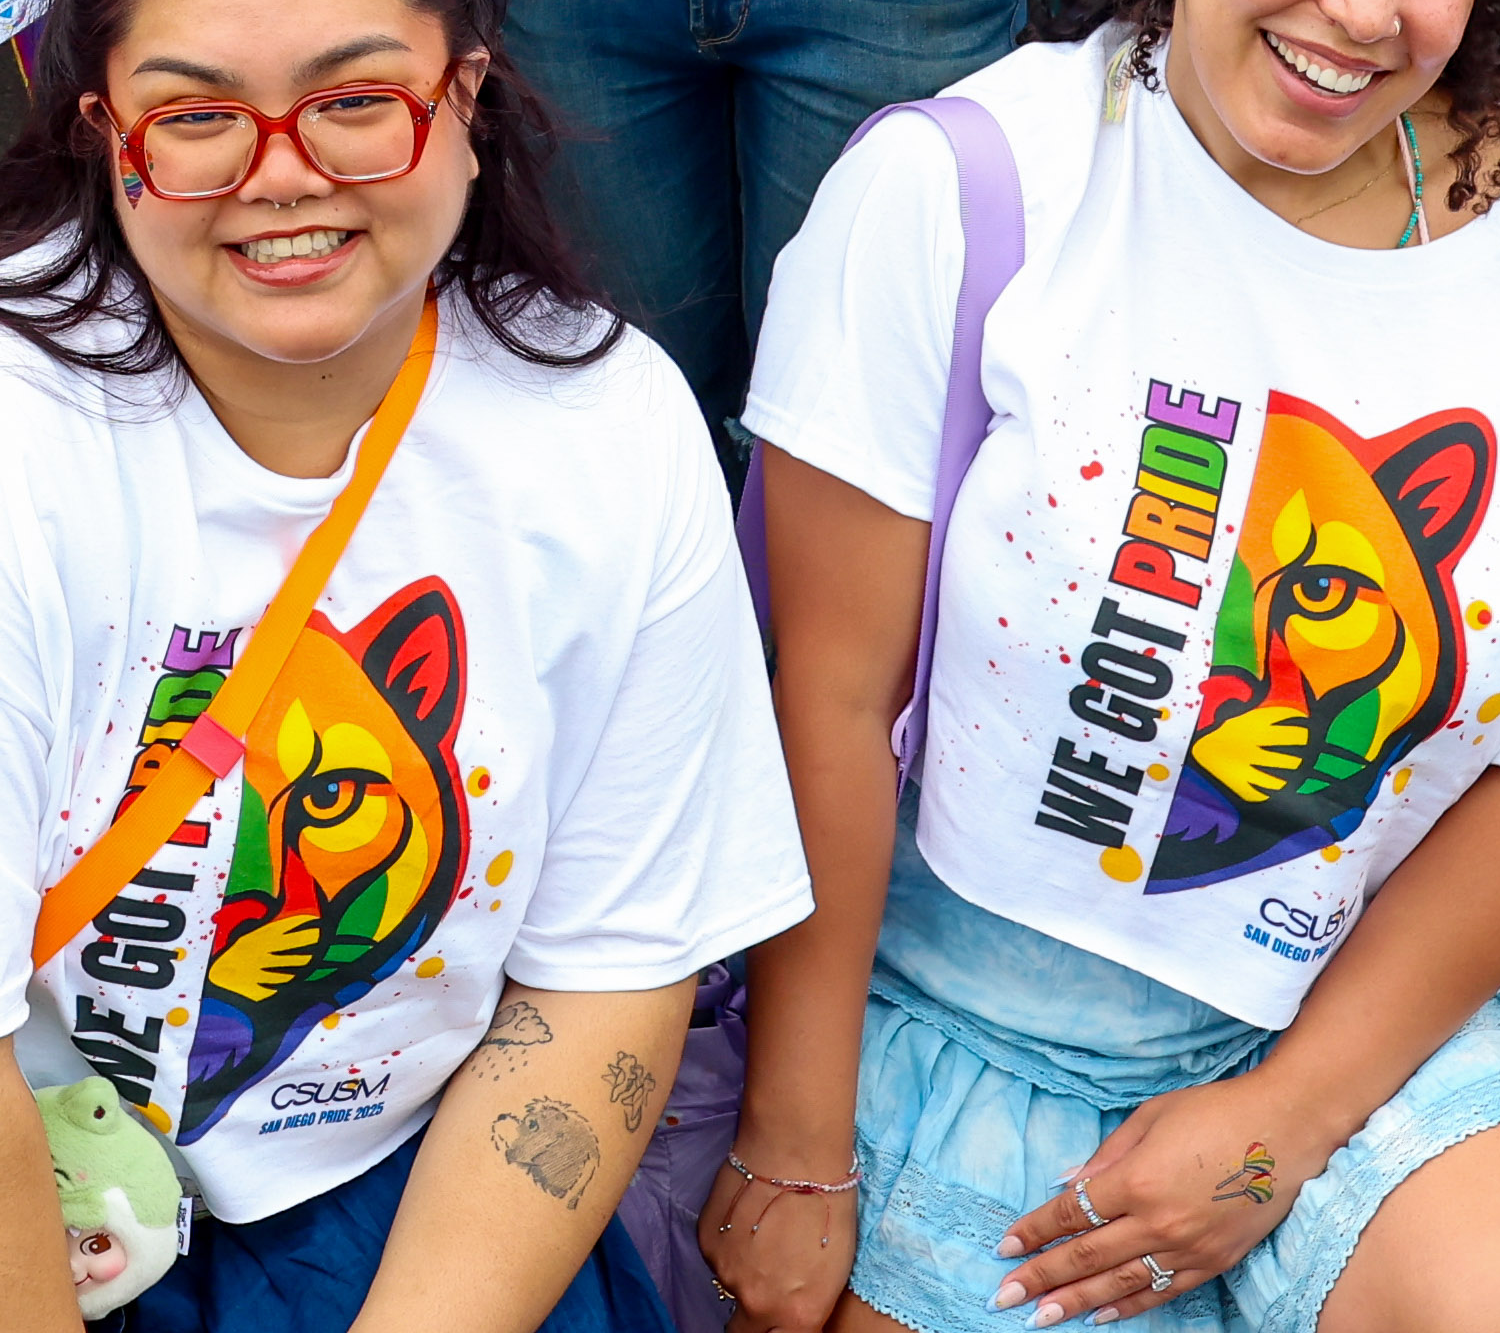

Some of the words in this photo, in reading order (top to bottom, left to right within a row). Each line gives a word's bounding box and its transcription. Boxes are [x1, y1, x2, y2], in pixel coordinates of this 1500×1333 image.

[1106, 377, 1241, 610] PRIDE
[1067, 599, 1189, 745] GOT
[1036, 736, 1146, 850] WE
[80, 867, 189, 990] GOT
[1243, 924, 1270, 948] SAN
[1272, 936, 1311, 963] DIEGO
[71, 990, 166, 1106] WE
[271, 1073, 391, 1110] CSUSM
[259, 1117, 281, 1134] SAN
[283, 1111, 317, 1130] DIEGO
[318, 1107, 351, 1126] PRIDE
[354, 1102, 385, 1122] 2025
